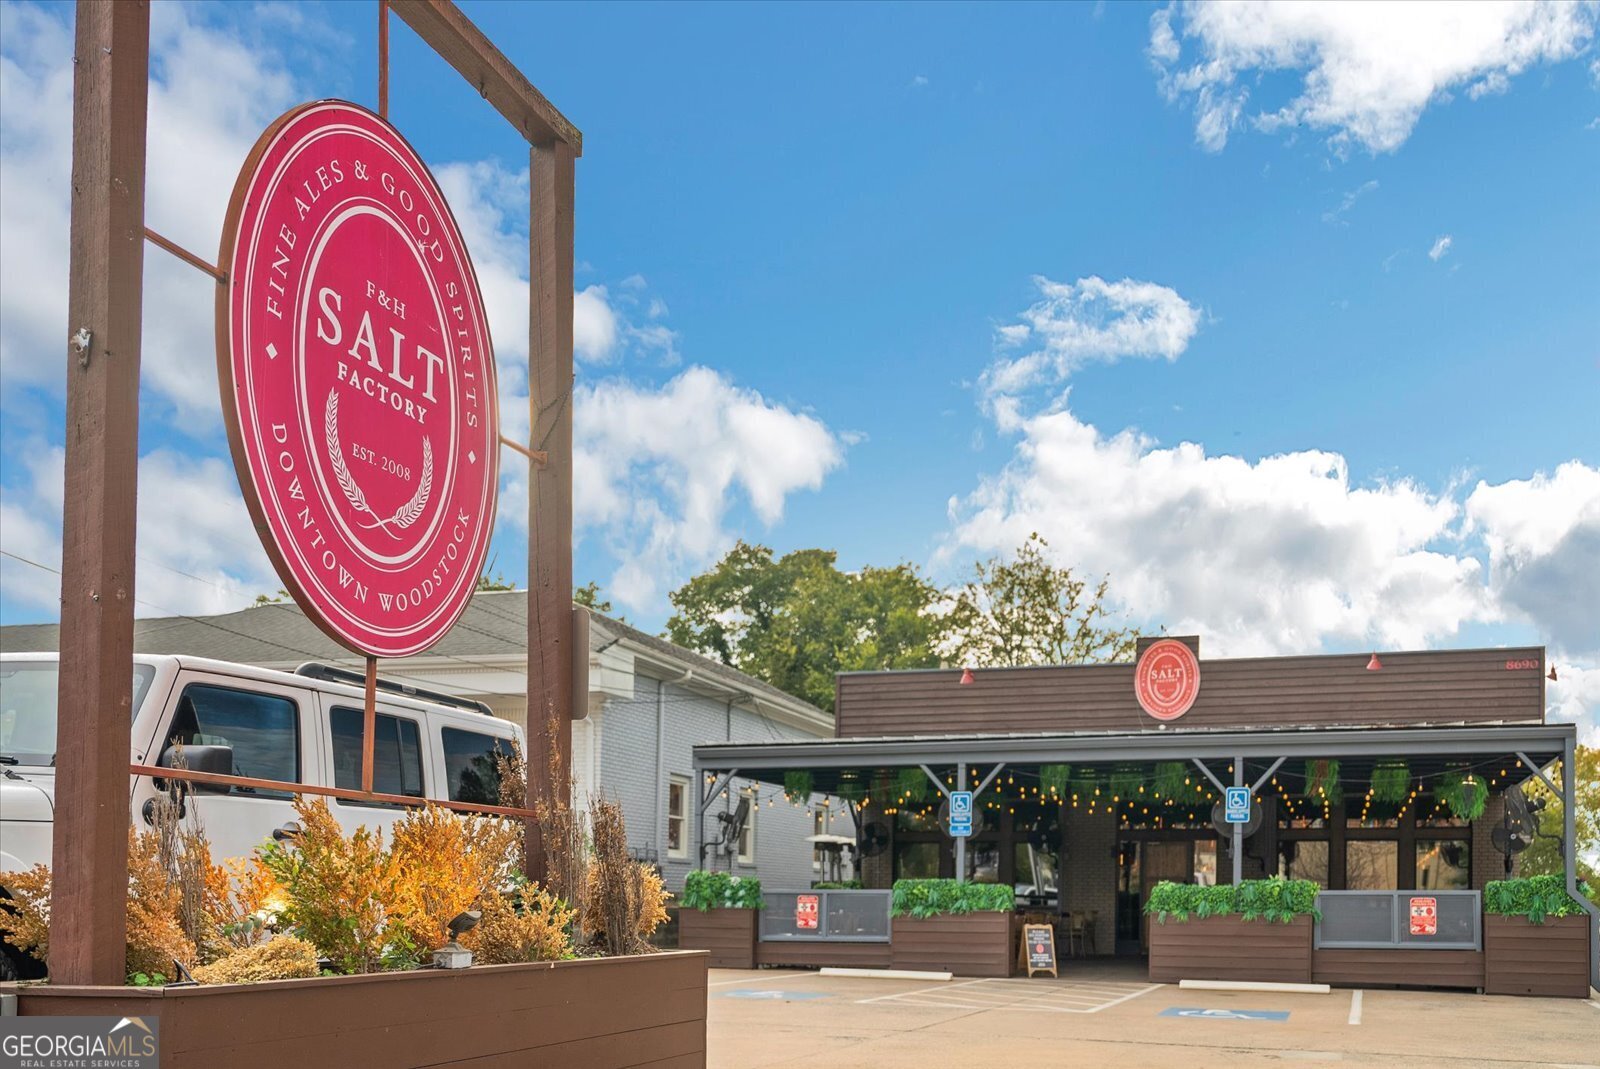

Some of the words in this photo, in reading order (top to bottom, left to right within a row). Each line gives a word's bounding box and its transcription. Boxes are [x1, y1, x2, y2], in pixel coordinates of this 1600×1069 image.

[267, 224, 297, 319] FINE
[295, 160, 344, 221] ALES
[354, 160, 369, 181] &
[382, 172, 443, 262] GOOD
[446, 282, 478, 428] SPIRITS
[367, 280, 406, 319] F&H
[317, 287, 443, 404] SALT
[337, 361, 427, 425] FACTORY
[352, 443, 377, 466] EST.
[382, 456, 411, 481] 2008
[272, 423, 368, 603] DOWNTOWN
[378, 507, 470, 612] WOODSTOCK
[1151, 668, 1182, 679] SALT
[1505, 659, 1539, 670] 8690
